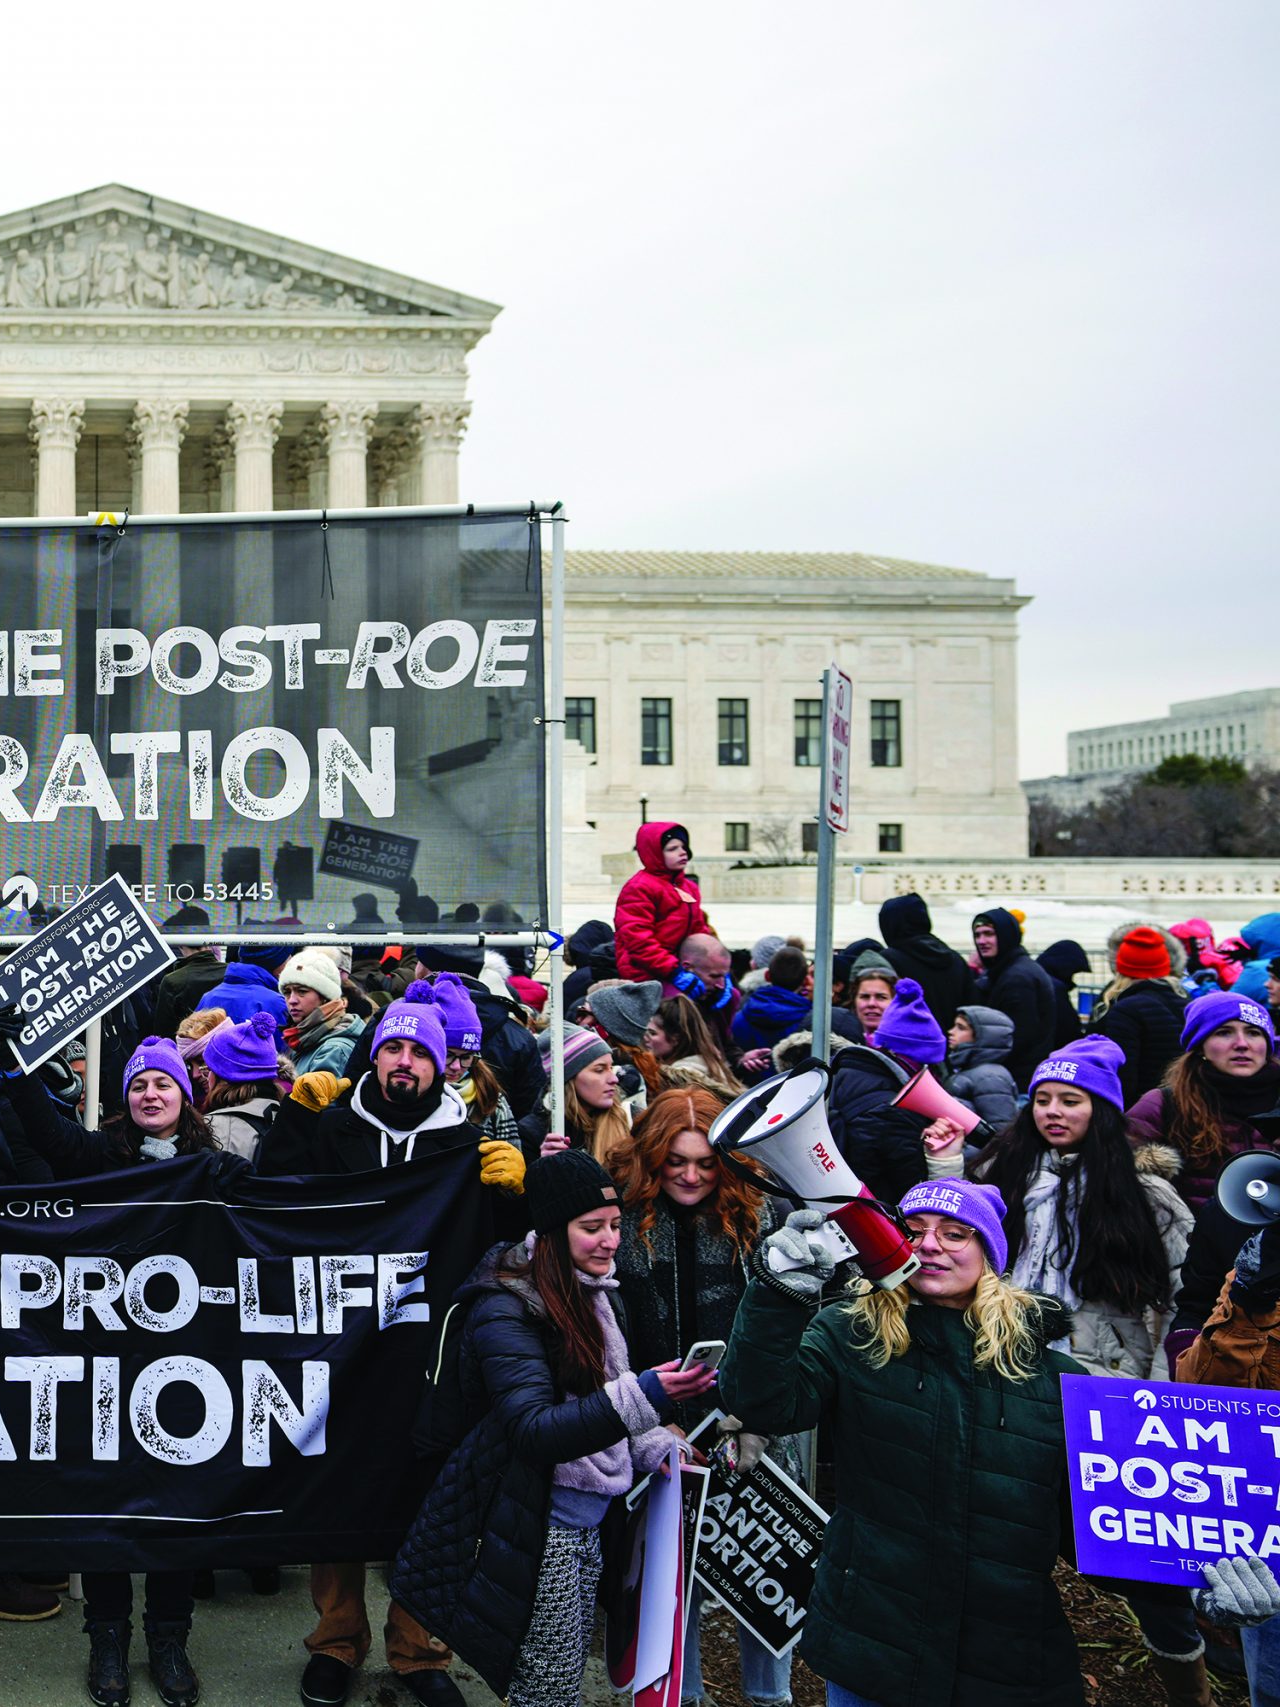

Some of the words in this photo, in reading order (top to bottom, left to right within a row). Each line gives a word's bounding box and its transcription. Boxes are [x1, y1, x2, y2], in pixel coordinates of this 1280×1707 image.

[95, 619, 537, 695] POST-ROE
[325, 855, 407, 879] GENERATIO
[327, 841, 411, 870] POST-ROE
[345, 834, 371, 847] AM
[378, 841, 409, 856] THE
[163, 884, 195, 902] TO
[202, 881, 274, 900] 53445
[15, 899, 101, 968] STUDENTSFORLIFE.ORG
[20, 946, 60, 987] AM
[65, 900, 121, 946] THE
[20, 937, 154, 1045] GENERATION
[62, 1015, 79, 1030] TEXT
[79, 1006, 94, 1019] LIFE
[92, 997, 104, 1009] TO
[103, 981, 124, 1000] 53445
[383, 1015, 420, 1030] PRO-LIFE
[902, 1198, 959, 1214] GENERATION
[906, 1186, 963, 1206] PRO-LIFE
[0, 1250, 431, 1335] PRO-LIFE
[1161, 1395, 1251, 1416] STUDENTS
[1089, 1409, 1103, 1442] I
[1135, 1415, 1231, 1454] AM
[1079, 1452, 1280, 1511] POST-
[705, 1492, 789, 1569] ANTI-
[739, 1485, 813, 1559] FUTURE
[699, 1515, 808, 1629] ORTION
[720, 1579, 743, 1602] 53445
